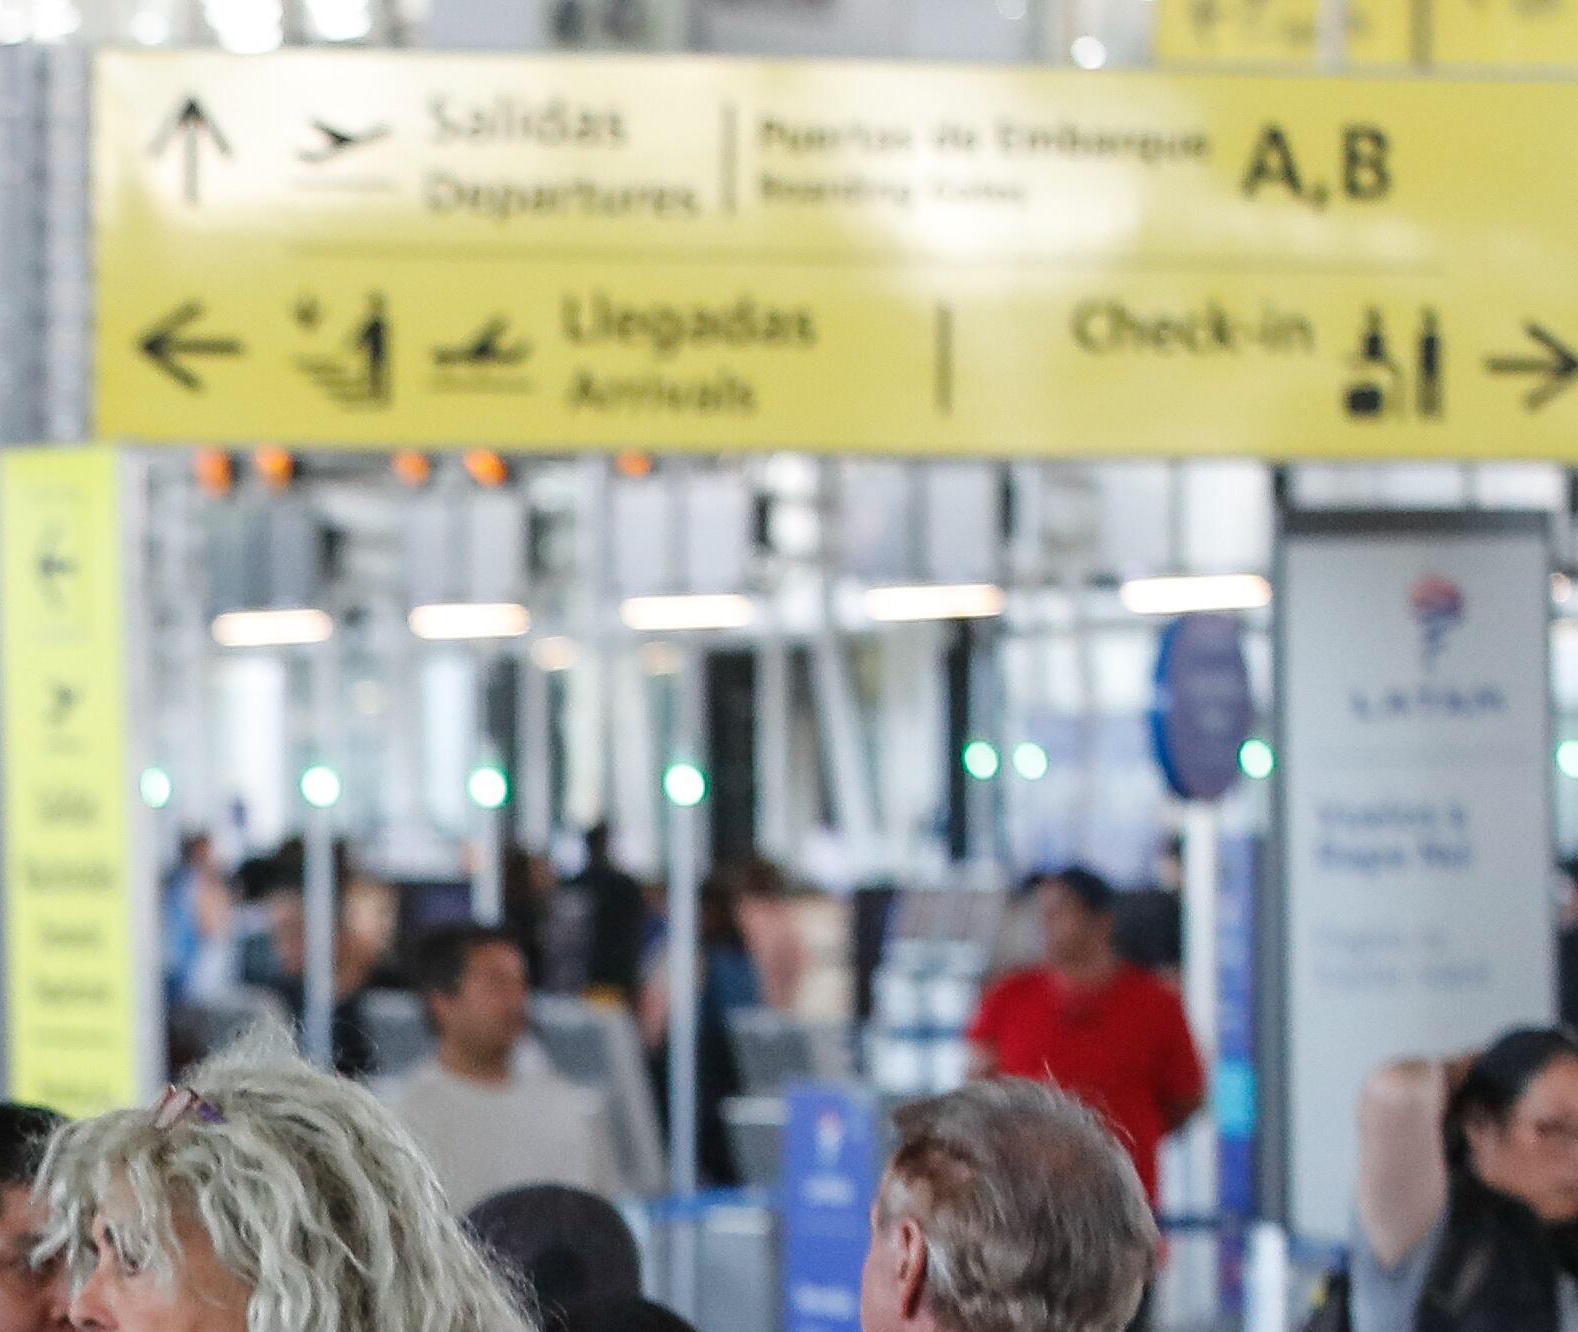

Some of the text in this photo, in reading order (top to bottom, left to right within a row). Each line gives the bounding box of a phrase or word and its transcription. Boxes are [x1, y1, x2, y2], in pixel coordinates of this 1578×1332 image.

[423, 97, 630, 149] Salidas
[1241, 121, 1394, 211] A,B
[422, 175, 703, 220] Departures
[558, 295, 820, 359] Llegadas
[1068, 297, 1317, 357] Check-in
[564, 371, 757, 414] Arrivals
